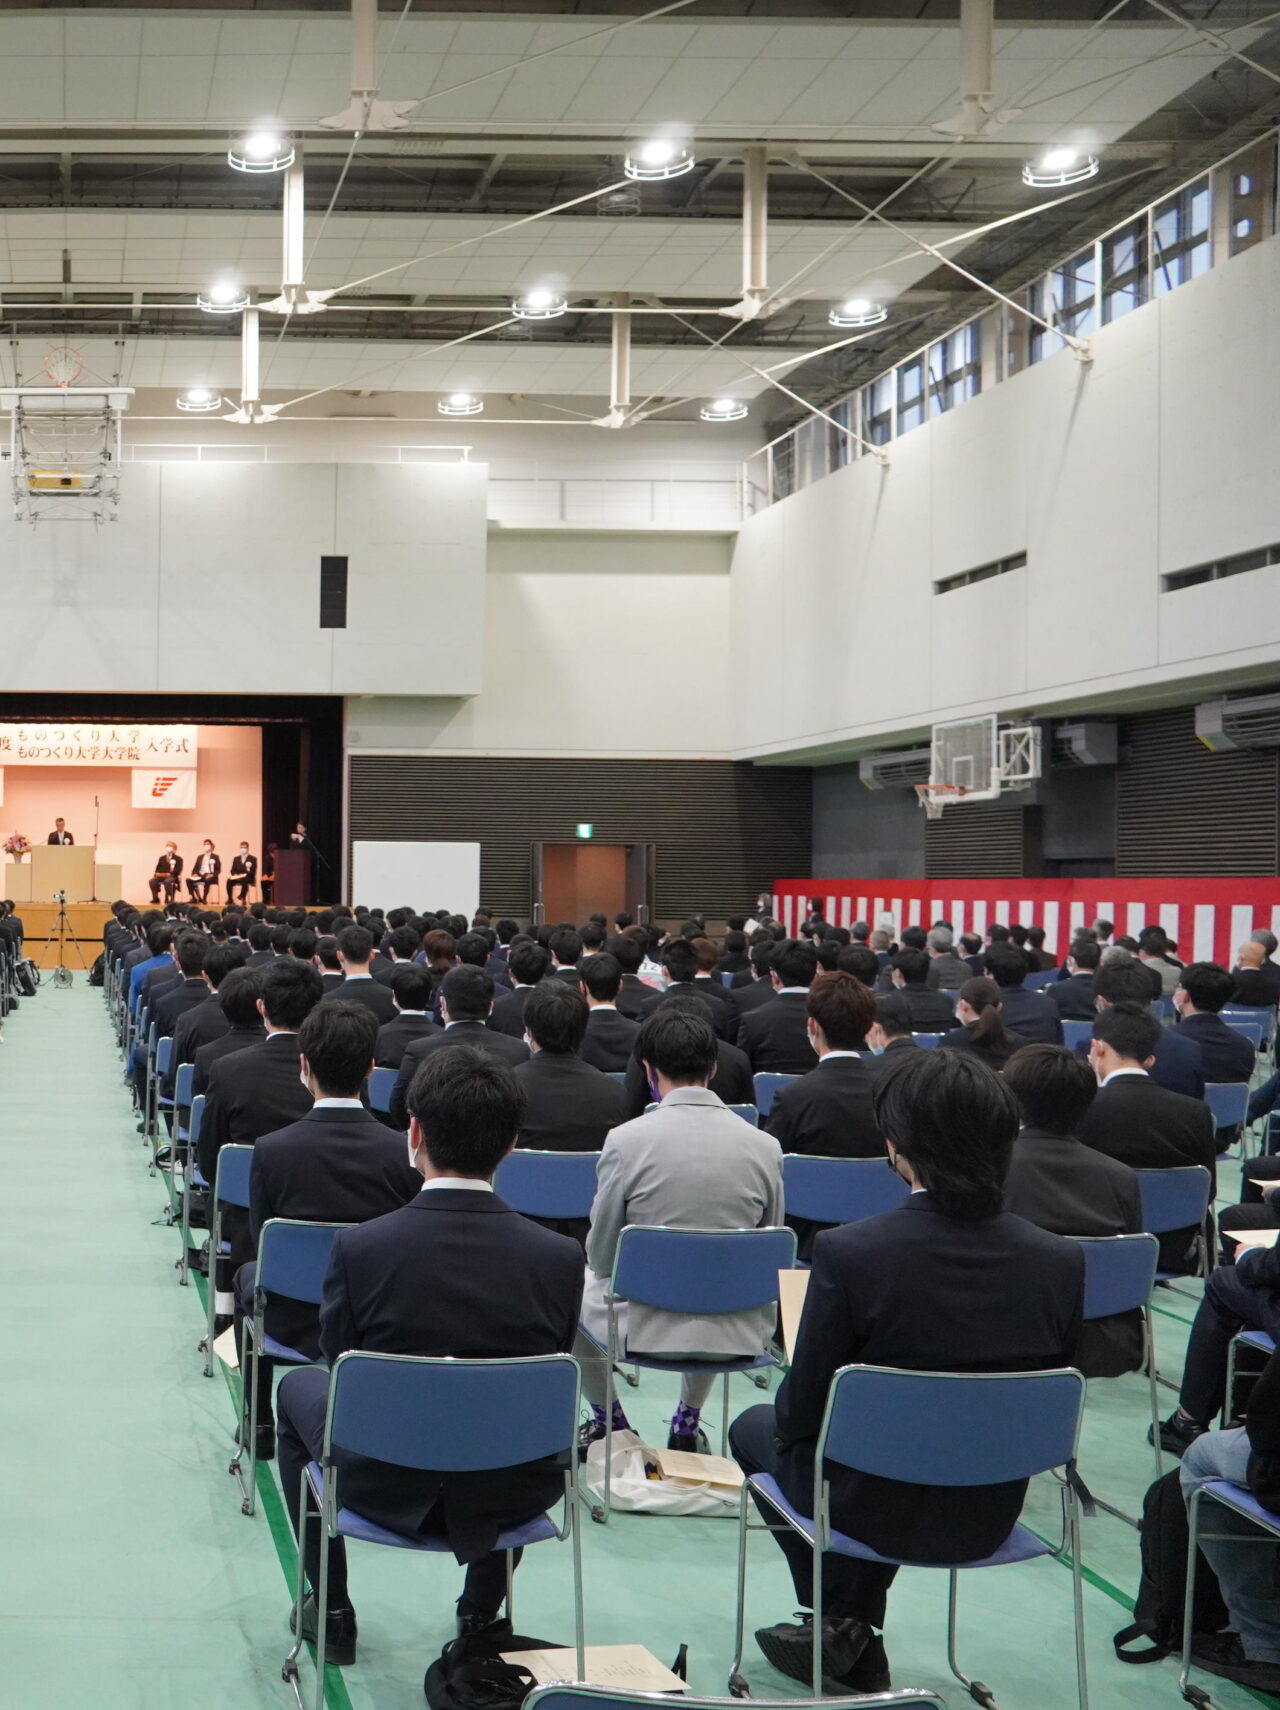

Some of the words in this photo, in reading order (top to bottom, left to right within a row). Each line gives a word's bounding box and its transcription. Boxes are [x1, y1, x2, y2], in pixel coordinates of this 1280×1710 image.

[145, 737, 189, 753] 入学式
[18, 746, 140, 760] ものつくり大学大学院
